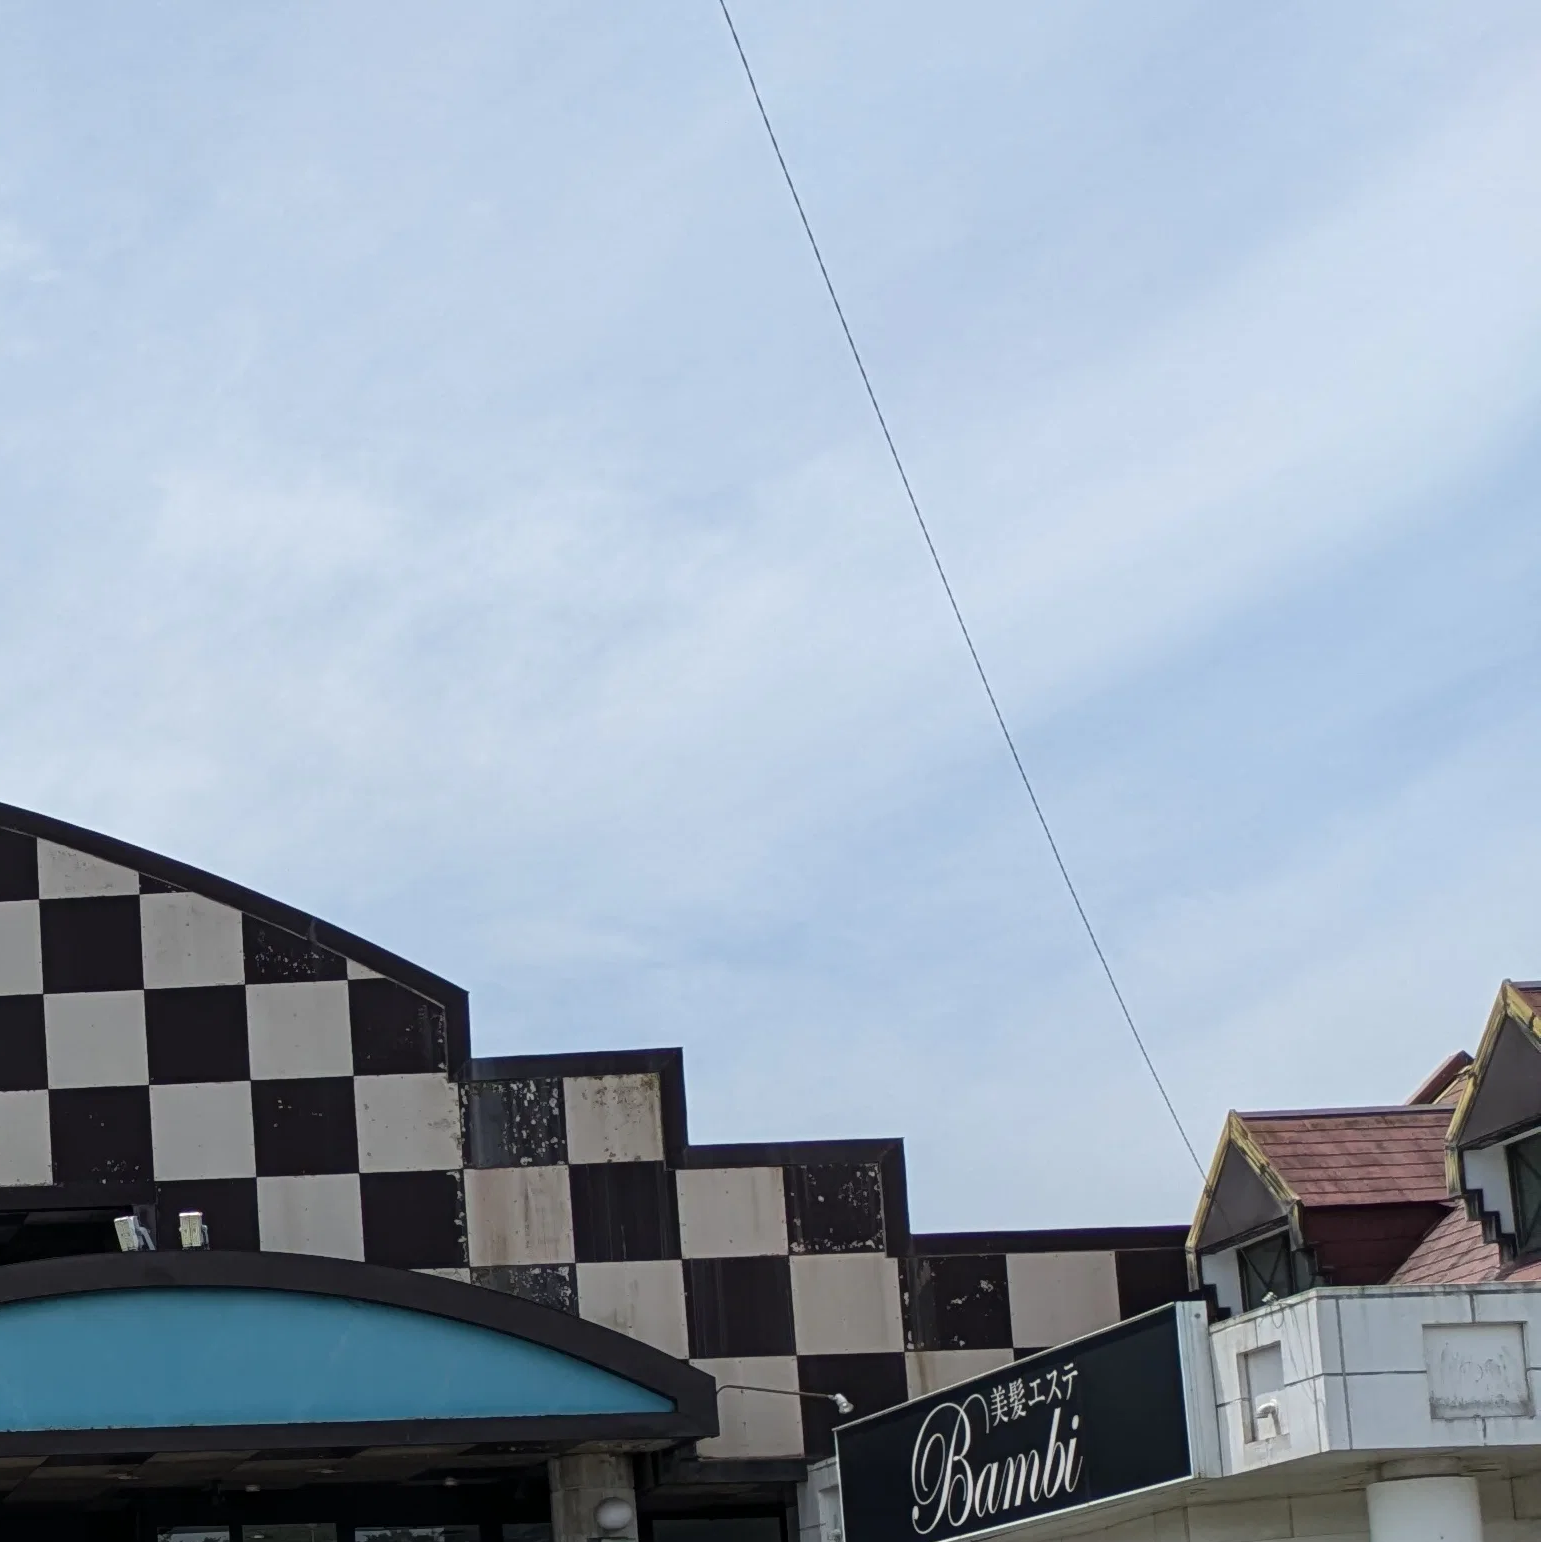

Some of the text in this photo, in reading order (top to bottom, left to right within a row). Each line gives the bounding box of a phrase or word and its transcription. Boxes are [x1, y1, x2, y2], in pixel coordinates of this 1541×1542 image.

[990, 1363, 1079, 1427] 美髪エステ
[912, 1394, 1083, 1534] Bambi
